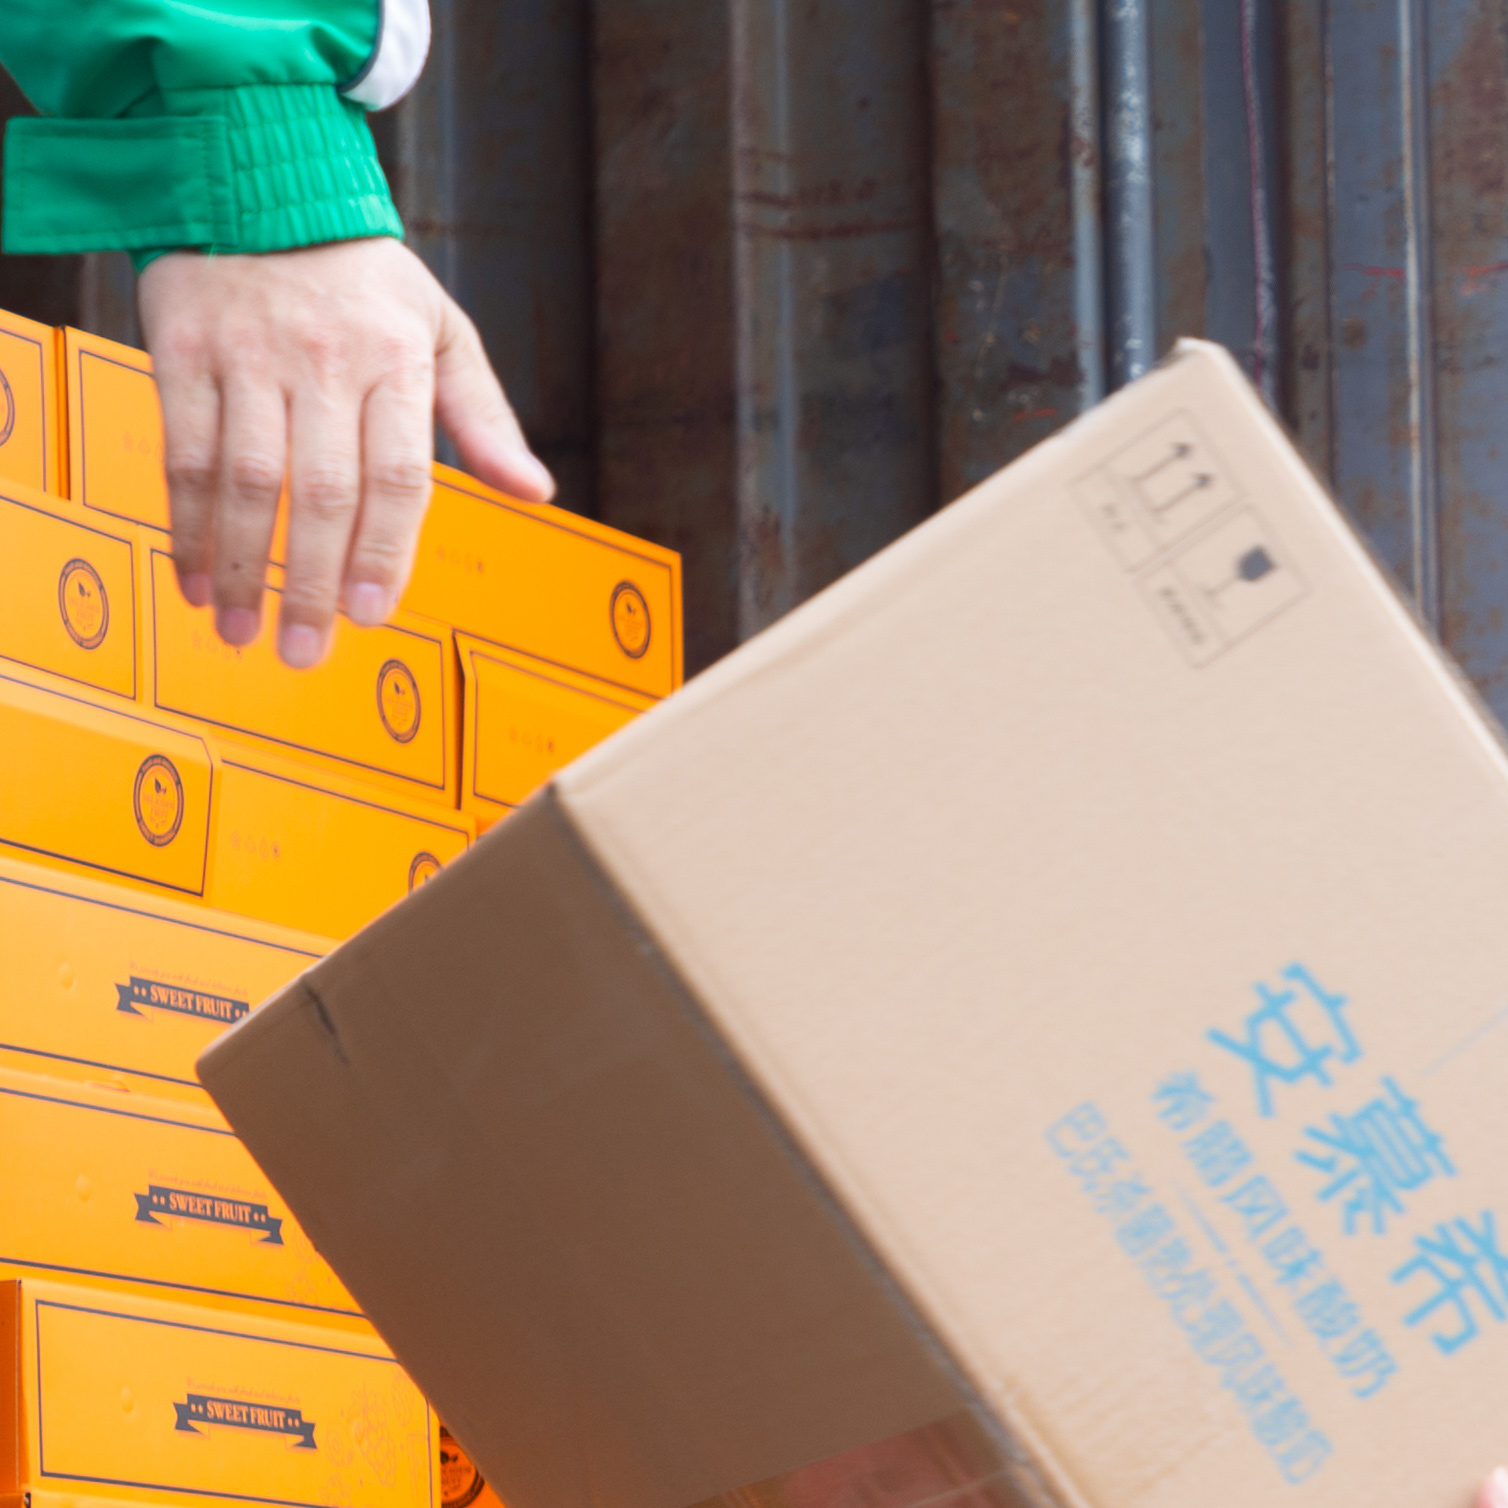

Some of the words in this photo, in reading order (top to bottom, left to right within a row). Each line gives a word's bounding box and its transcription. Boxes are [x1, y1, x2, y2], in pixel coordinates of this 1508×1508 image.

[150, 984, 193, 1010] SWEET
[195, 995, 234, 1020] FRUIT
[169, 1192, 212, 1217] SWEET
[214, 1200, 251, 1224] FRUIT
[1153, 1070, 1397, 1399] 希腊风味酸奶
[206, 1400, 248, 1423] SWEET
[250, 1407, 286, 1429] FRUIT
